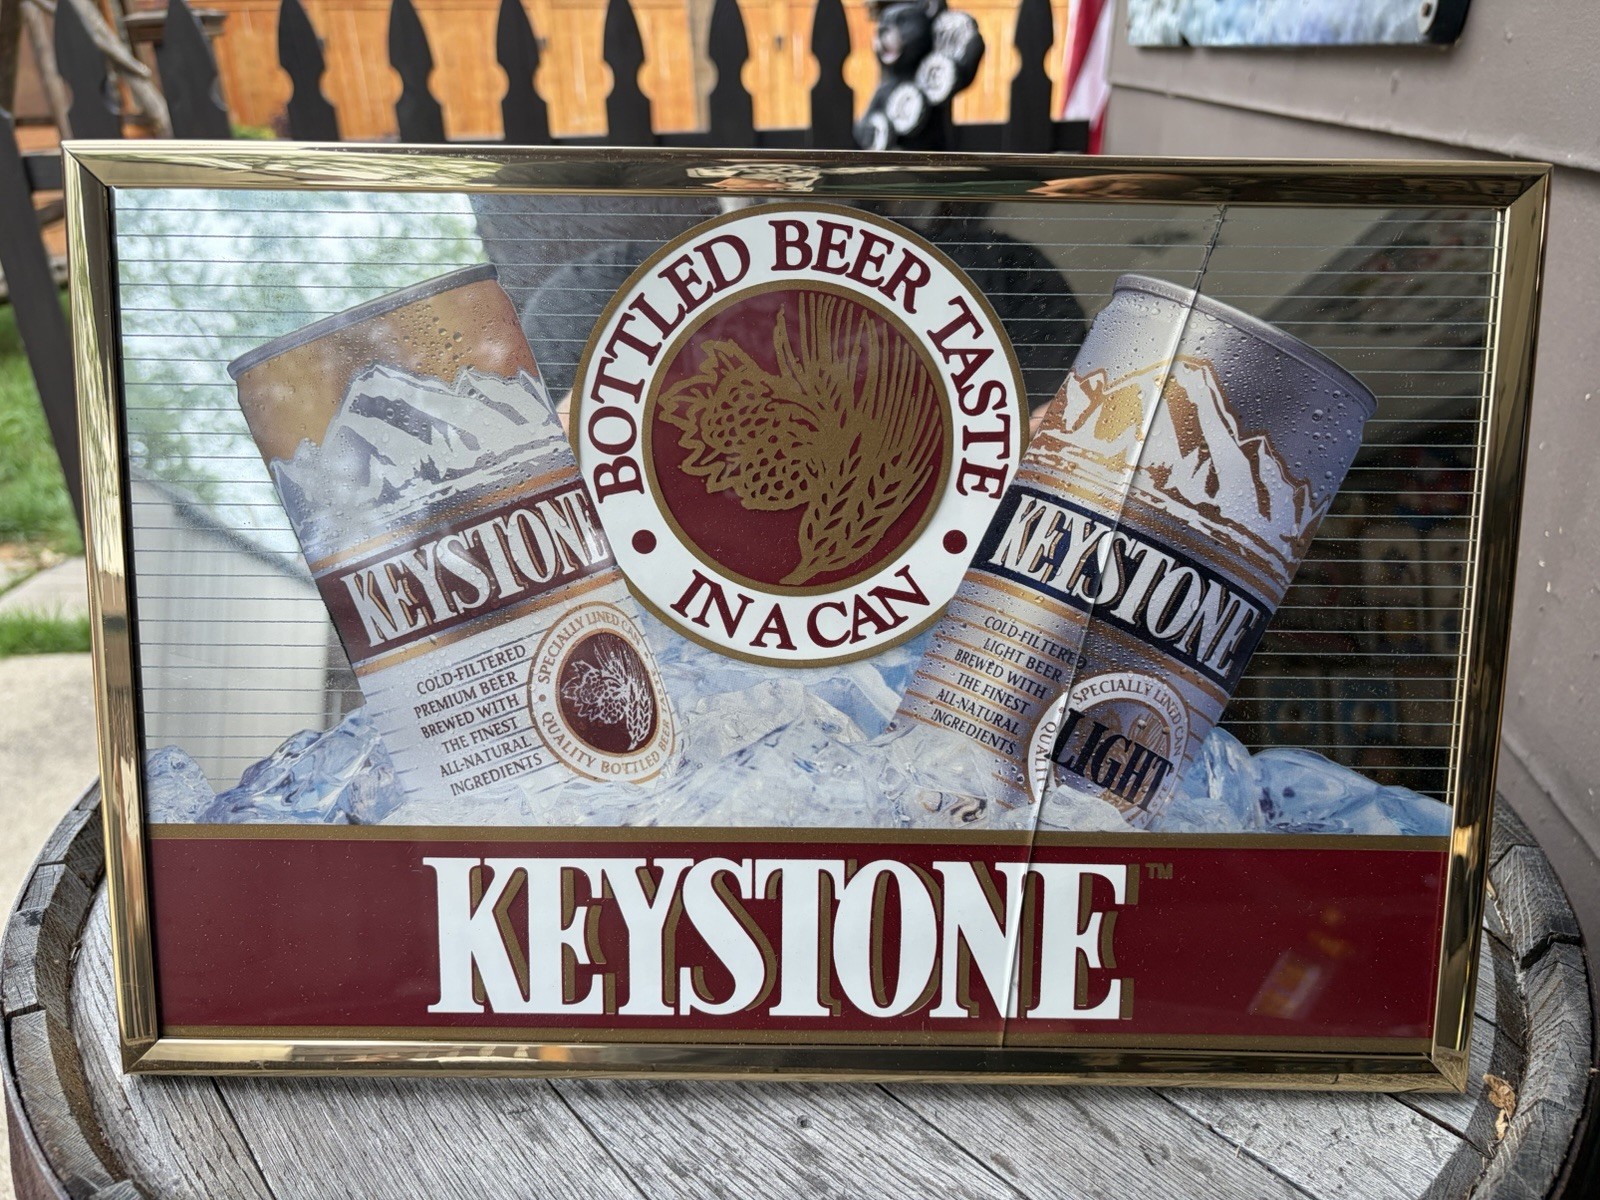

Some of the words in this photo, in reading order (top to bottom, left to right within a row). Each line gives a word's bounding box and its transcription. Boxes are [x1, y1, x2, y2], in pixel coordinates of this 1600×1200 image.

[588, 234, 750, 503] BOTTLED
[769, 219, 931, 315] BEER
[927, 296, 1011, 499] TASTE
[340, 488, 609, 648] KEYSTONE
[988, 493, 1261, 678] KEYSTONE
[670, 570, 755, 638] IN
[749, 603, 798, 650] A
[806, 565, 931, 648] CAN
[538, 616, 584, 684] SPECIALLY
[586, 611, 619, 625] LINED
[983, 637, 1025, 664] LIGHT
[1026, 655, 1063, 683] BEER
[984, 616, 1088, 670] COLD-FILTERED
[414, 686, 477, 719] PREMIUM
[479, 671, 518, 695] BEER
[417, 644, 526, 695] COLD-FILTERED
[954, 648, 1004, 679] BREWED
[1006, 670, 1048, 700] WITH
[956, 672, 980, 693] THE
[981, 686, 1030, 715] FINEST
[421, 711, 474, 739] BREWED
[476, 693, 520, 718] WITH
[936, 688, 1022, 736] ALL-NATURAL
[1072, 678, 1153, 705] SPECIALLY
[1152, 689, 1182, 724] LINED
[440, 735, 532, 778] ALL-NATURAL
[441, 735, 469, 754] THE
[470, 716, 519, 744] FINEST
[542, 711, 596, 768] QUALITY
[601, 751, 660, 774] BOTTLED
[931, 708, 1017, 756] INGREDIENTS
[450, 753, 543, 796] INGREDIENTS
[1044, 708, 1174, 812] LIGHT
[422, 856, 1135, 1019] KEYSTONE
